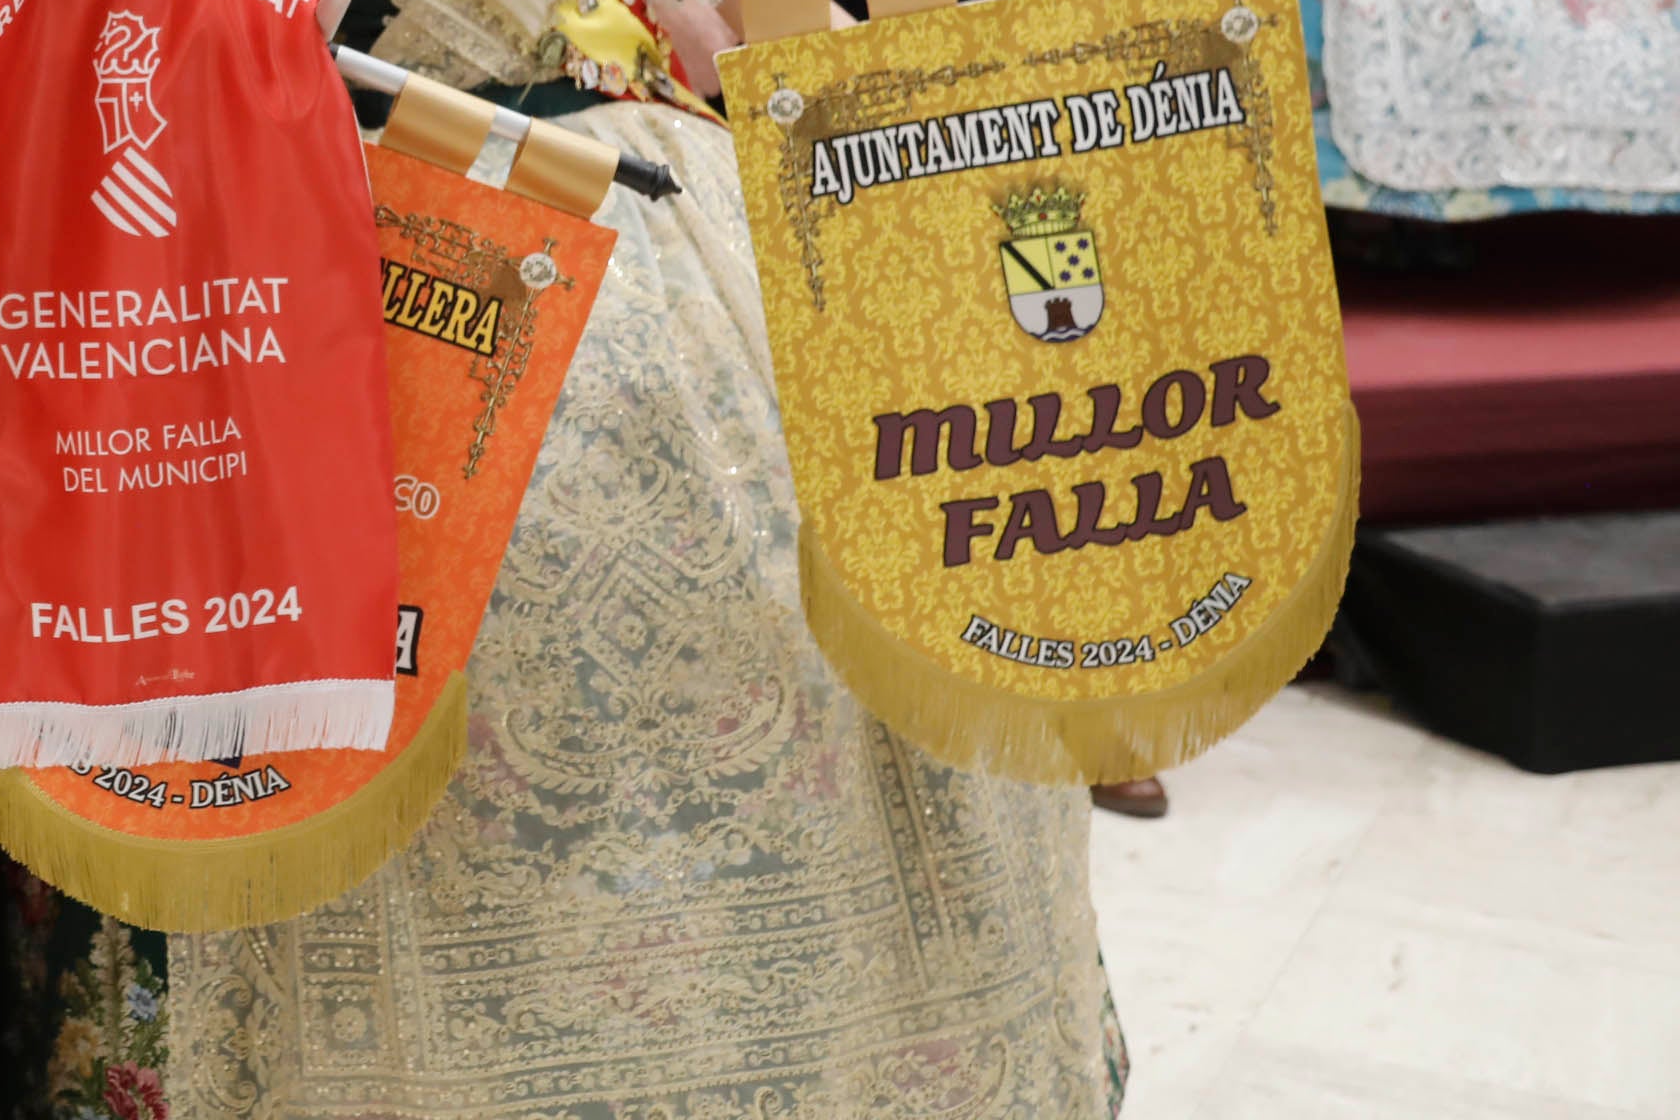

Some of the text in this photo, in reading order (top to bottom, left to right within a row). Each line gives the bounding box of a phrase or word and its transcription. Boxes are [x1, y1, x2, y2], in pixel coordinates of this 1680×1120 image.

[810, 61, 1245, 205] AJUNTAMENT DE DÉNIA
[0, 327, 286, 379] VALENCIANA
[55, 416, 242, 457] MILLOR FALLA
[873, 354, 1281, 481] MILLOR
[62, 452, 248, 494] DEL MUNICIPI
[941, 456, 1247, 567] FALLA
[30, 585, 303, 643] FALLES 2024
[961, 615, 1075, 669] FALLES
[1080, 637, 1155, 668] 2024
[1170, 572, 1251, 647] DÉNIA
[94, 765, 168, 808] 2024
[189, 765, 291, 809] DÉNIA
